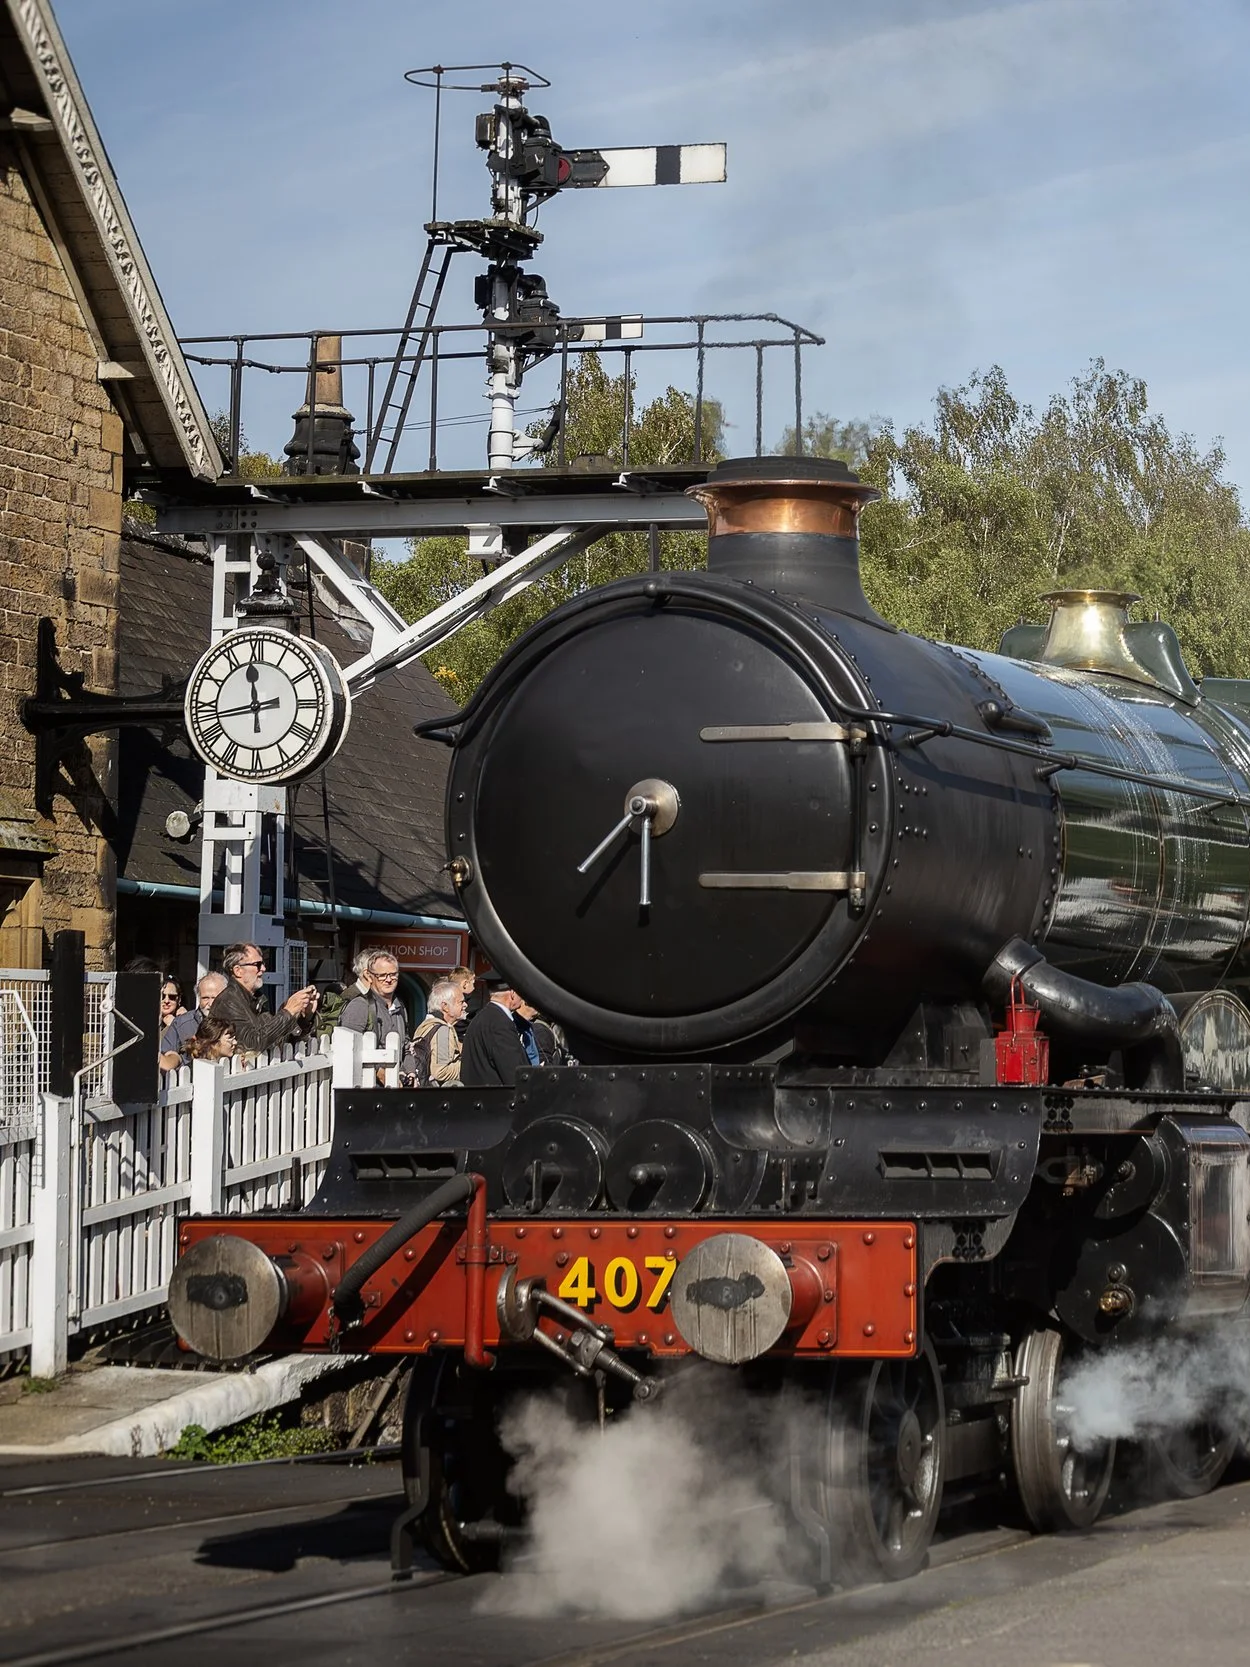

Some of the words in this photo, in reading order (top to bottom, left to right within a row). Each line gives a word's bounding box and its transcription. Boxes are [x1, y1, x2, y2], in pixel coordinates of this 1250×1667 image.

[250, 640, 264, 661] XII
[419, 945, 449, 957] SHOP
[558, 1256, 678, 1309] 407
